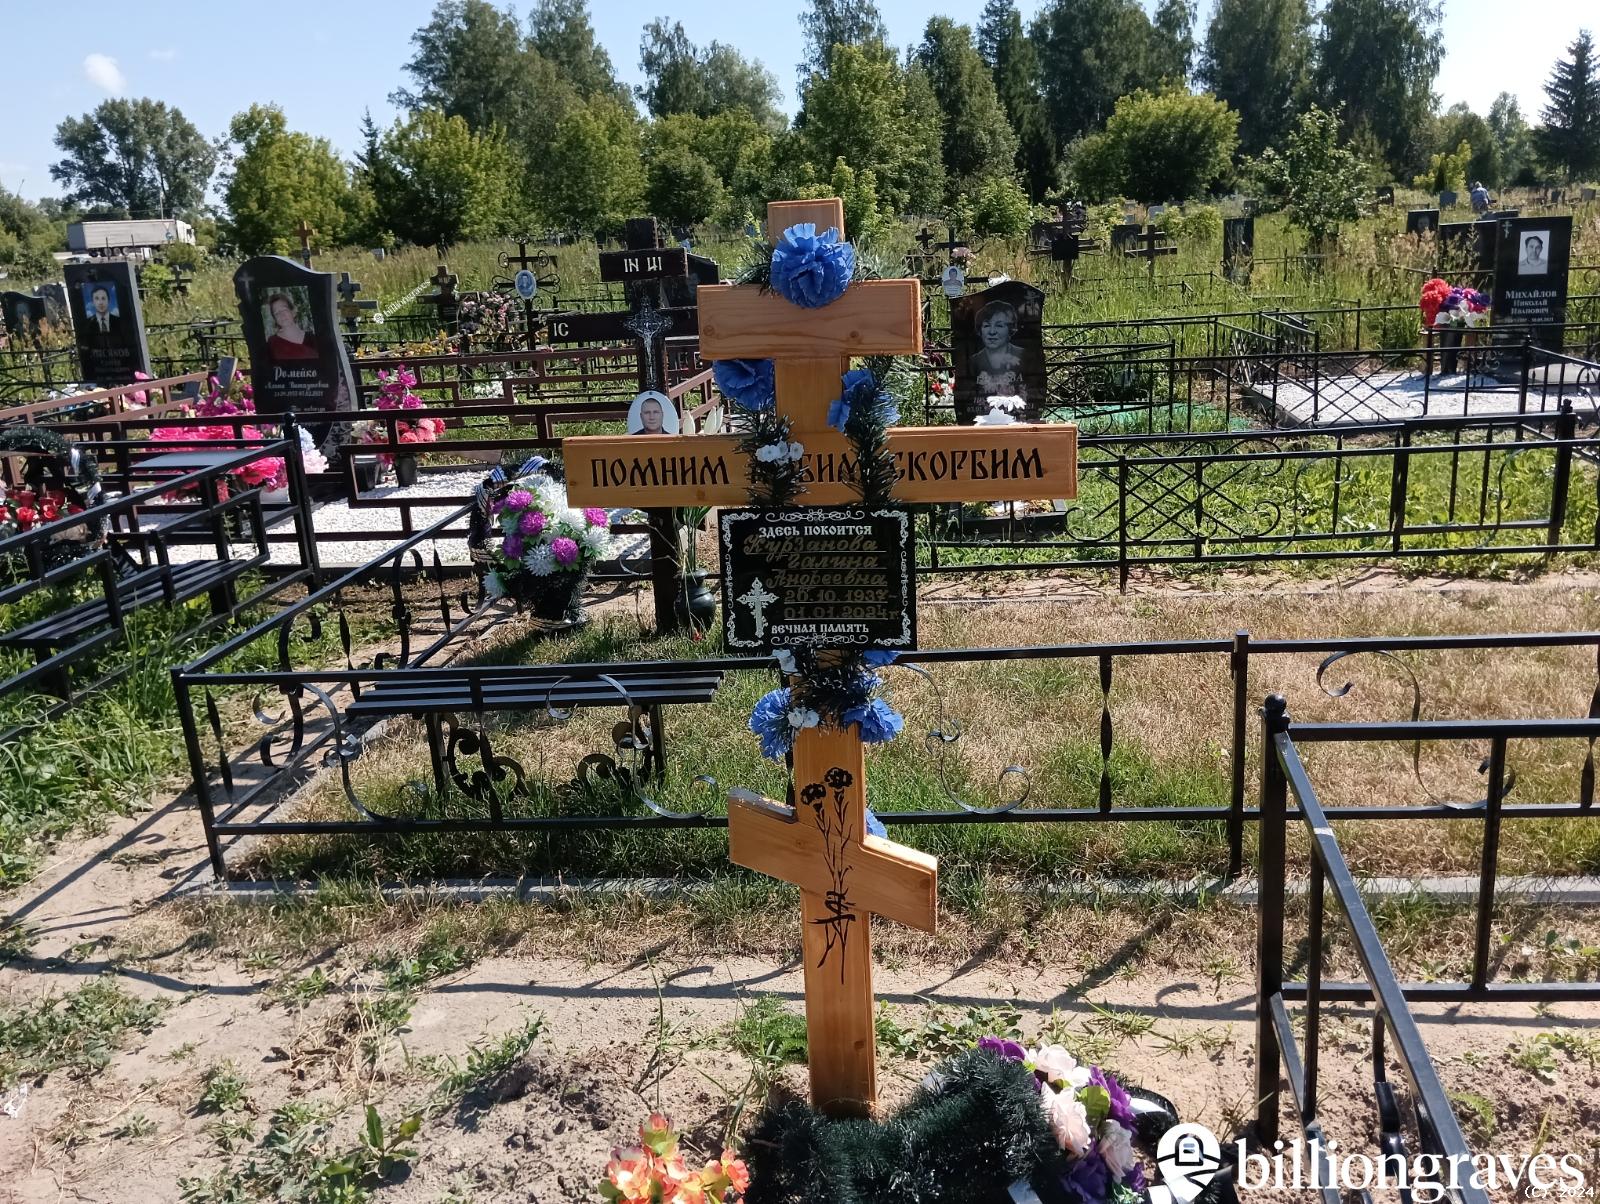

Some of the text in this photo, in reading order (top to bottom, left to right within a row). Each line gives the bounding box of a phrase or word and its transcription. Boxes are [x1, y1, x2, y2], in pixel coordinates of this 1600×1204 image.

[1505, 289, 1557, 299] МИХАЙЛОВ
[273, 366, 318, 381] Ромейко
[591, 447, 1045, 487] ПОМНИМ БИМ СКОРБИМ
[758, 525, 873, 538] ЗДЕСЬ ПОКОИТСЯ
[787, 554, 879, 568] Галина
[765, 569, 888, 587] Андреевна
[771, 623, 870, 635] ВЕЧНАЯ ПАМЯТЬ
